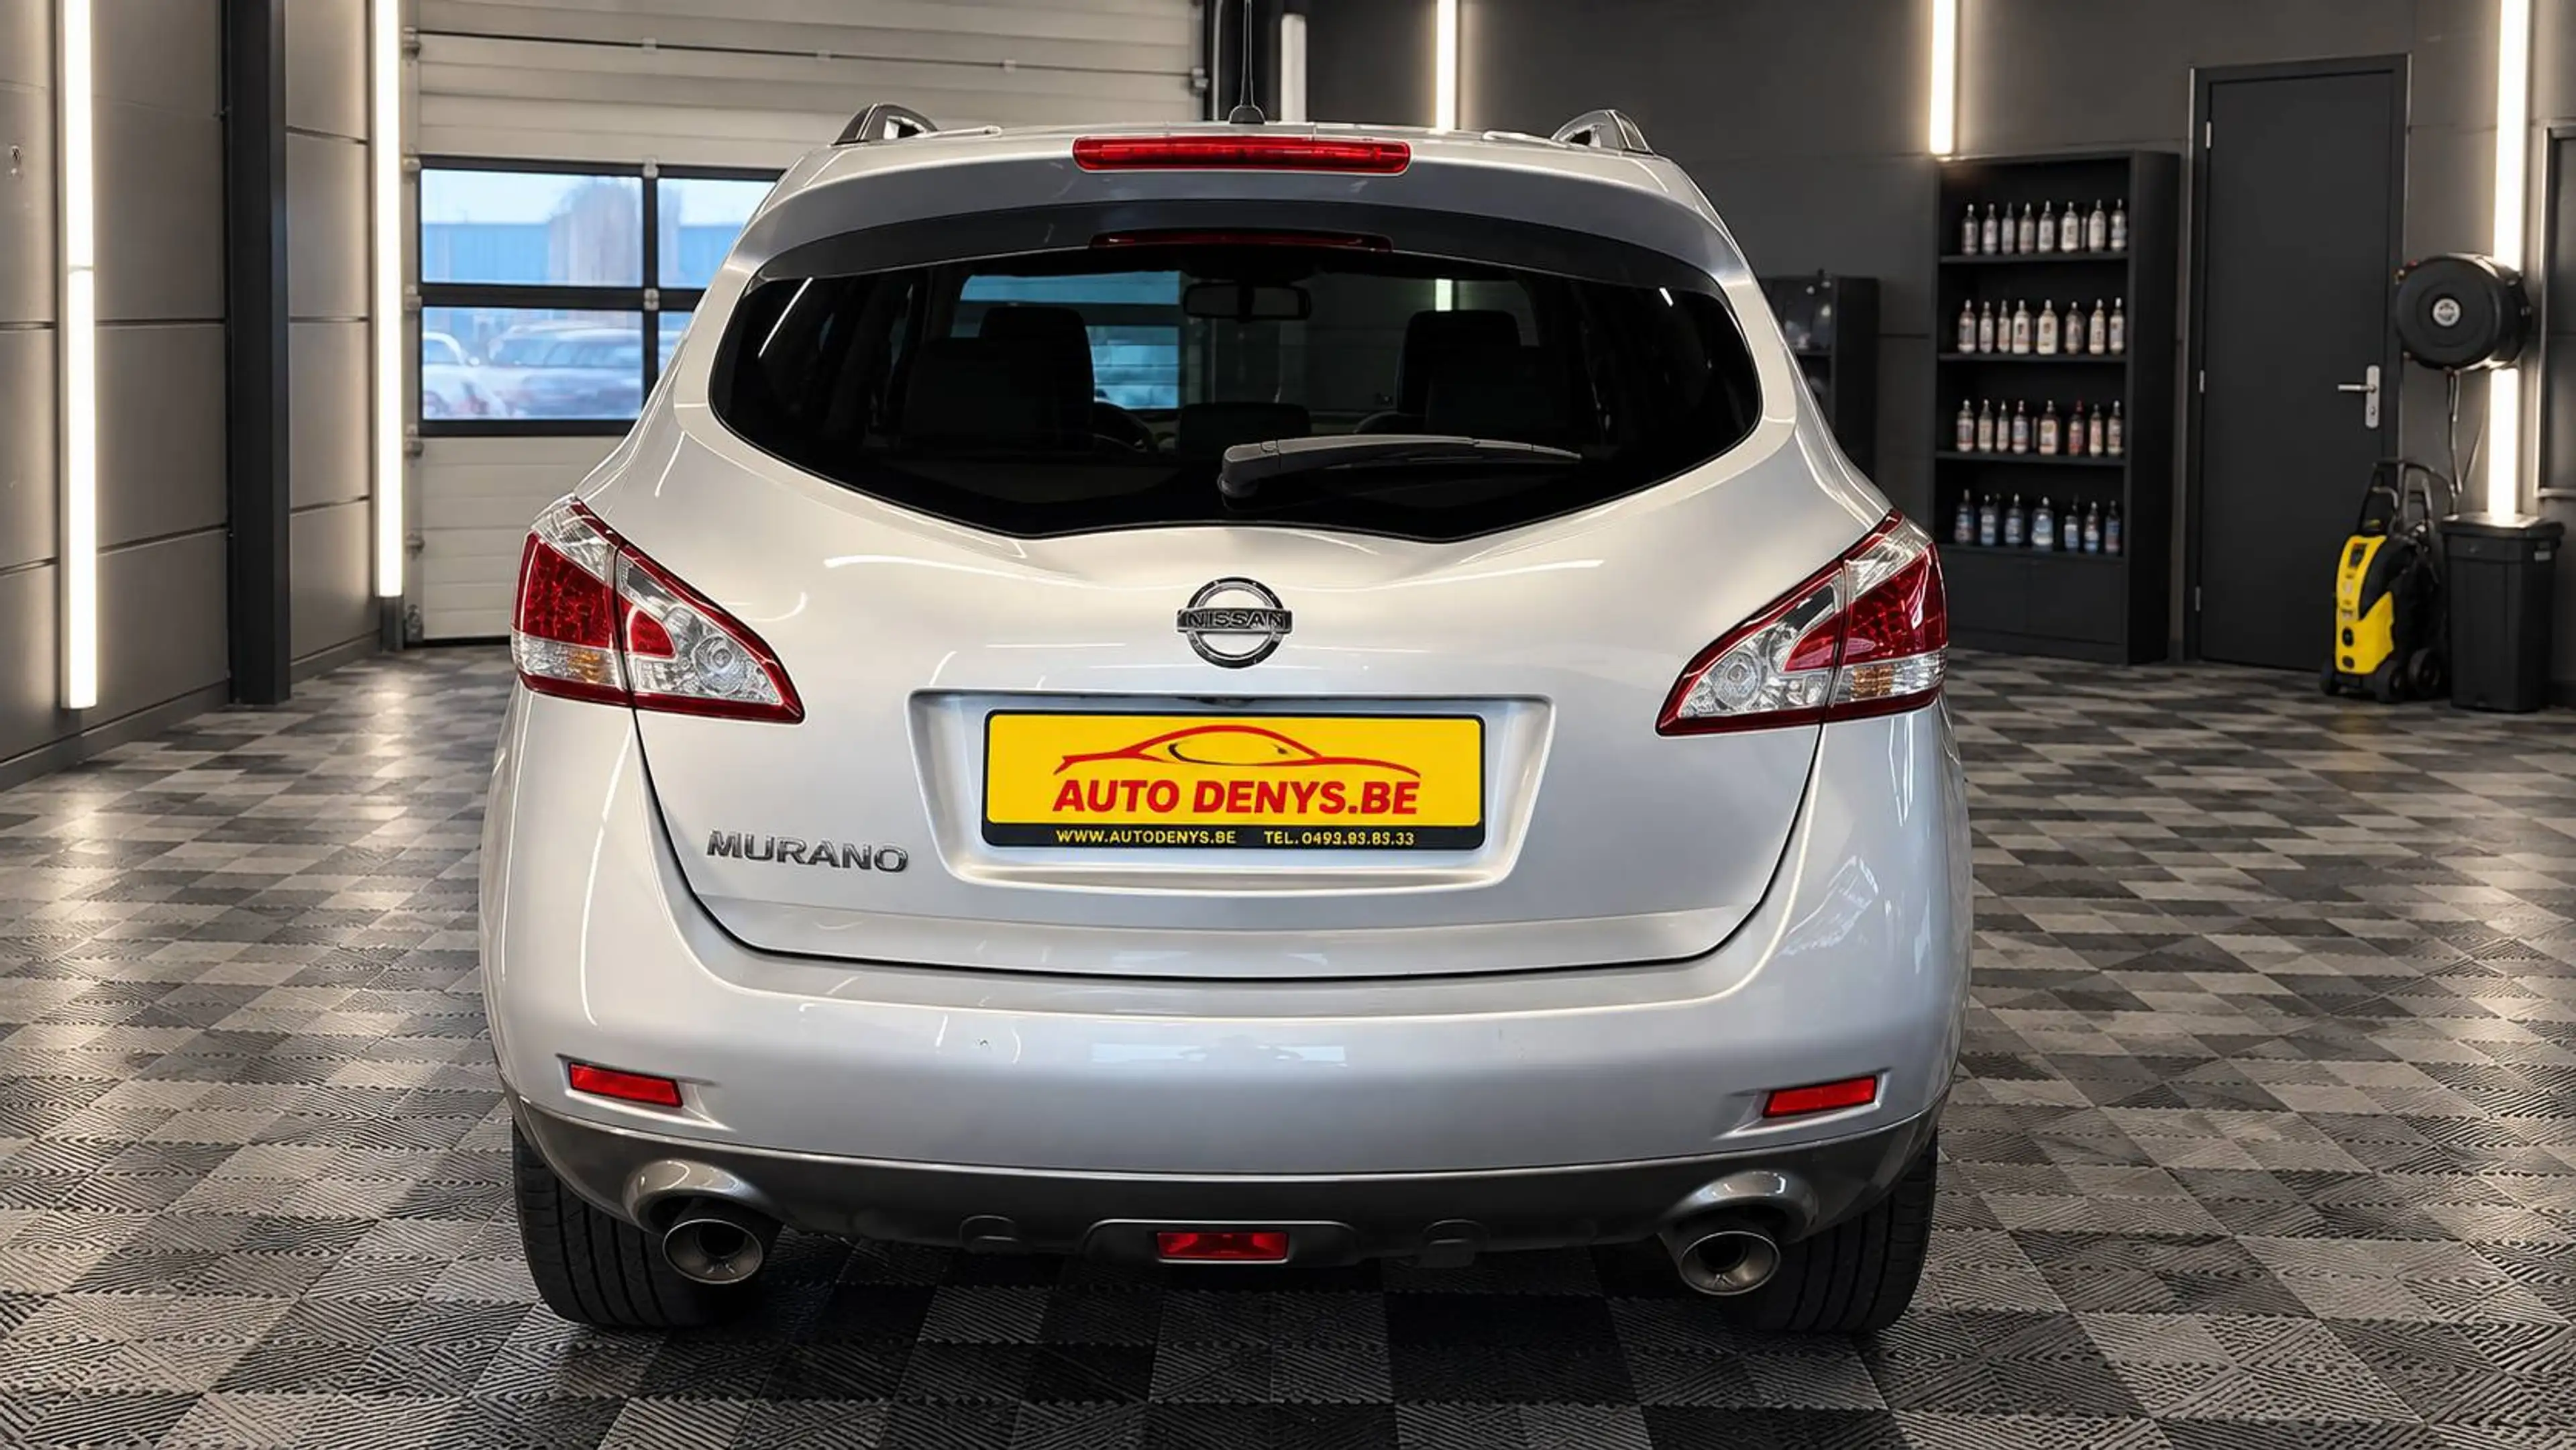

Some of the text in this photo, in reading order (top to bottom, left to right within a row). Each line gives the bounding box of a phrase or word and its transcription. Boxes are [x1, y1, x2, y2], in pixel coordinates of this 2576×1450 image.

[1187, 610, 1286, 630] NISSAN
[1053, 780, 1420, 815] AUTO DENYS.BE
[1056, 829, 1237, 844] WWW.AUTODENYS.BE
[706, 829, 909, 873] MURANO
